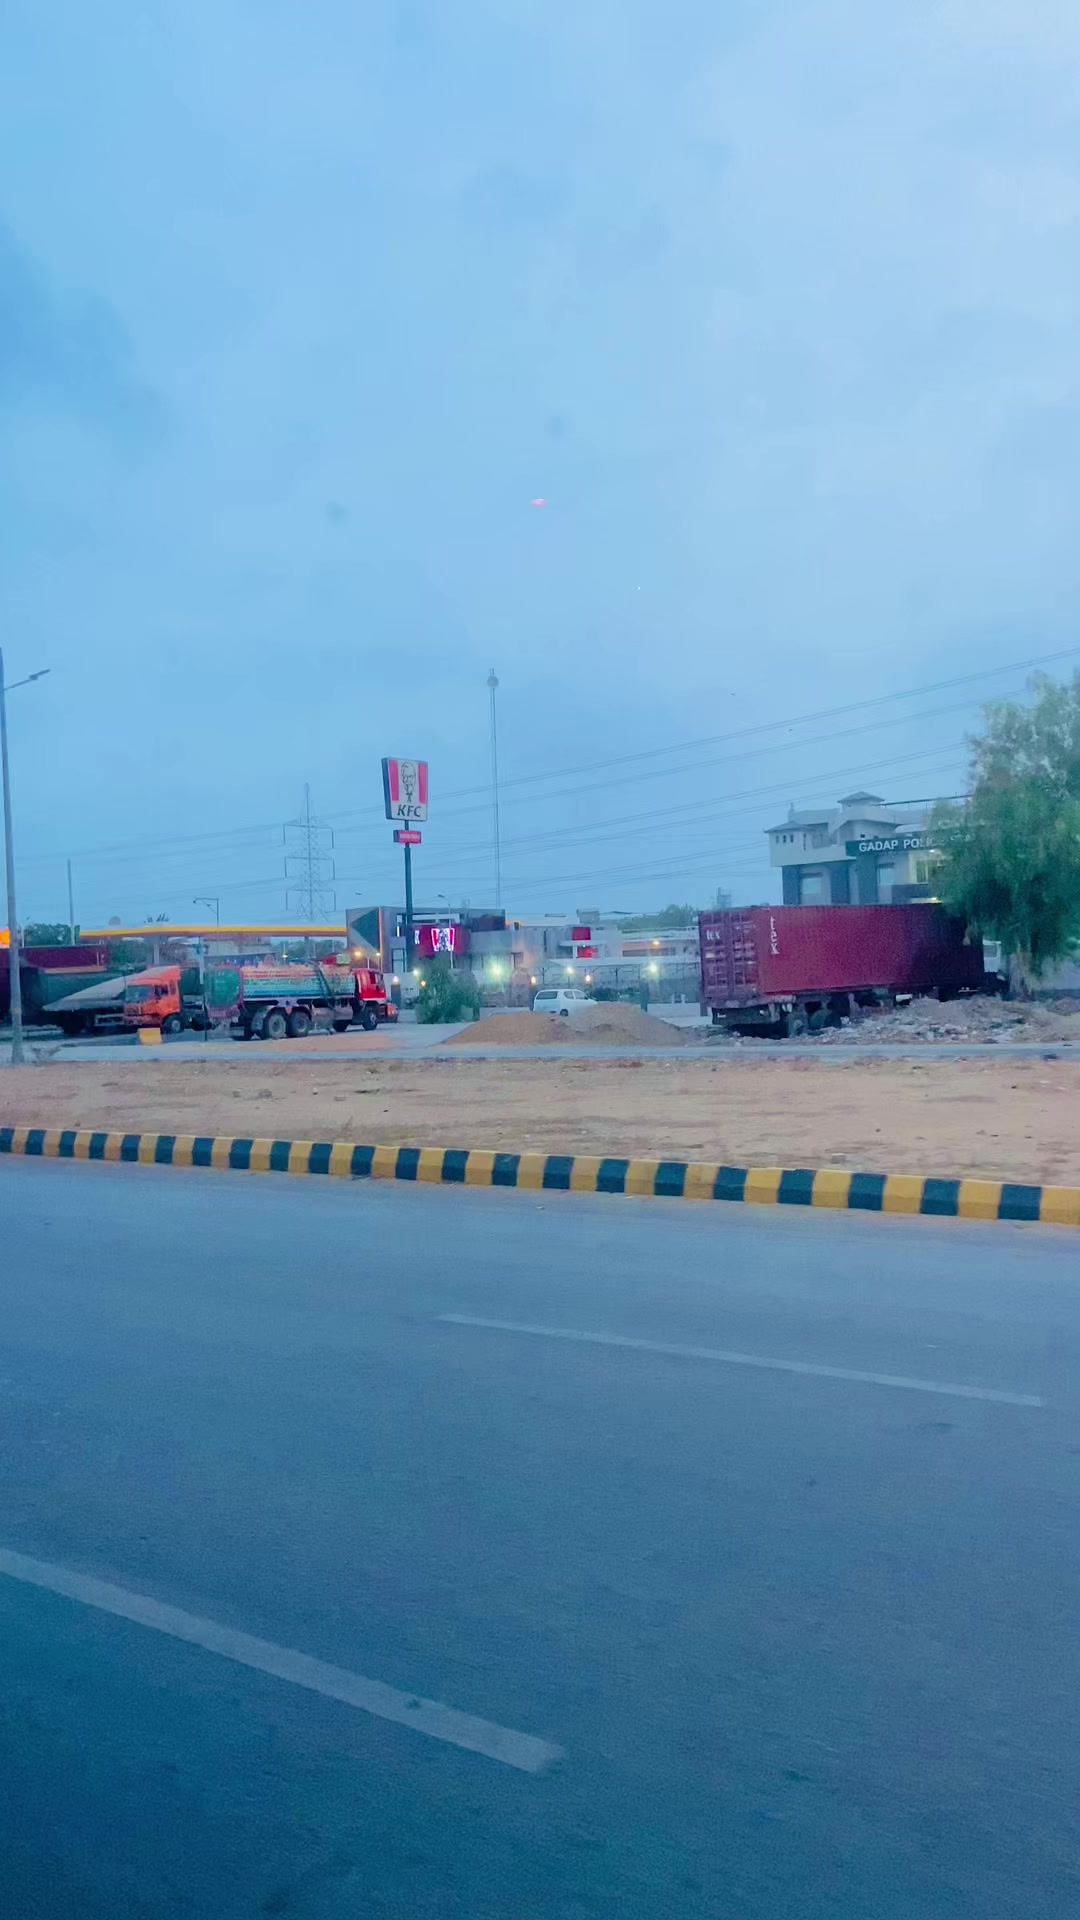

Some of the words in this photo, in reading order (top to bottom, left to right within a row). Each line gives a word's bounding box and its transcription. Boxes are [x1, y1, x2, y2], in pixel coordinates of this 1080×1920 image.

[397, 804, 421, 817] KFC
[859, 840, 898, 852] GADAP
[770, 916, 780, 954] tex
